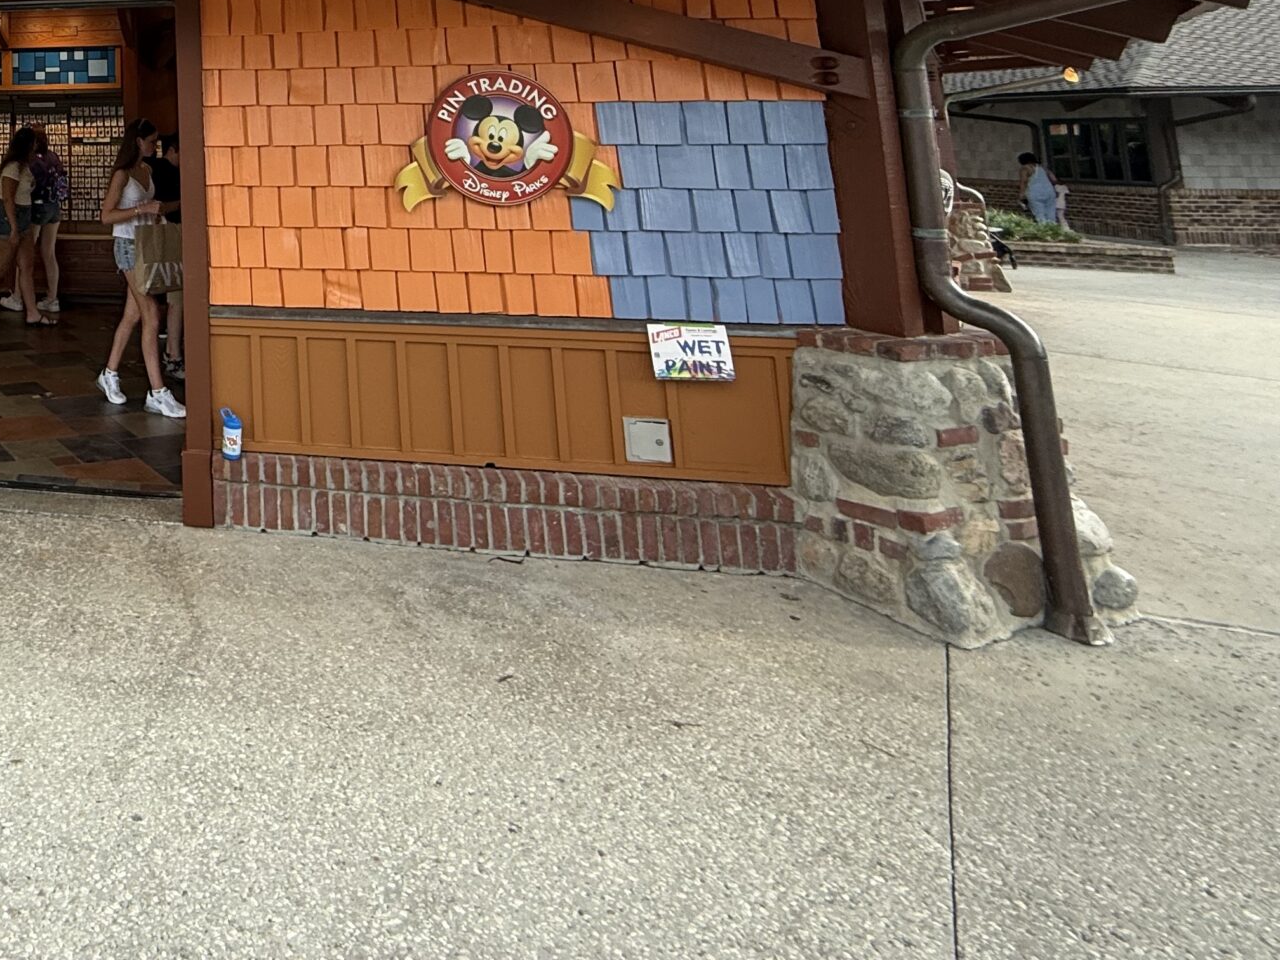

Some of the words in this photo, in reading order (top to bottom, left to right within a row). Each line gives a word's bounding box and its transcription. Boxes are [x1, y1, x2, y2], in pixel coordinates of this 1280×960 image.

[437, 90, 467, 124] PIN
[467, 76, 557, 121] TRADING
[462, 170, 510, 202] Disney
[676, 339, 725, 357] WET
[664, 359, 726, 377] PAINT
